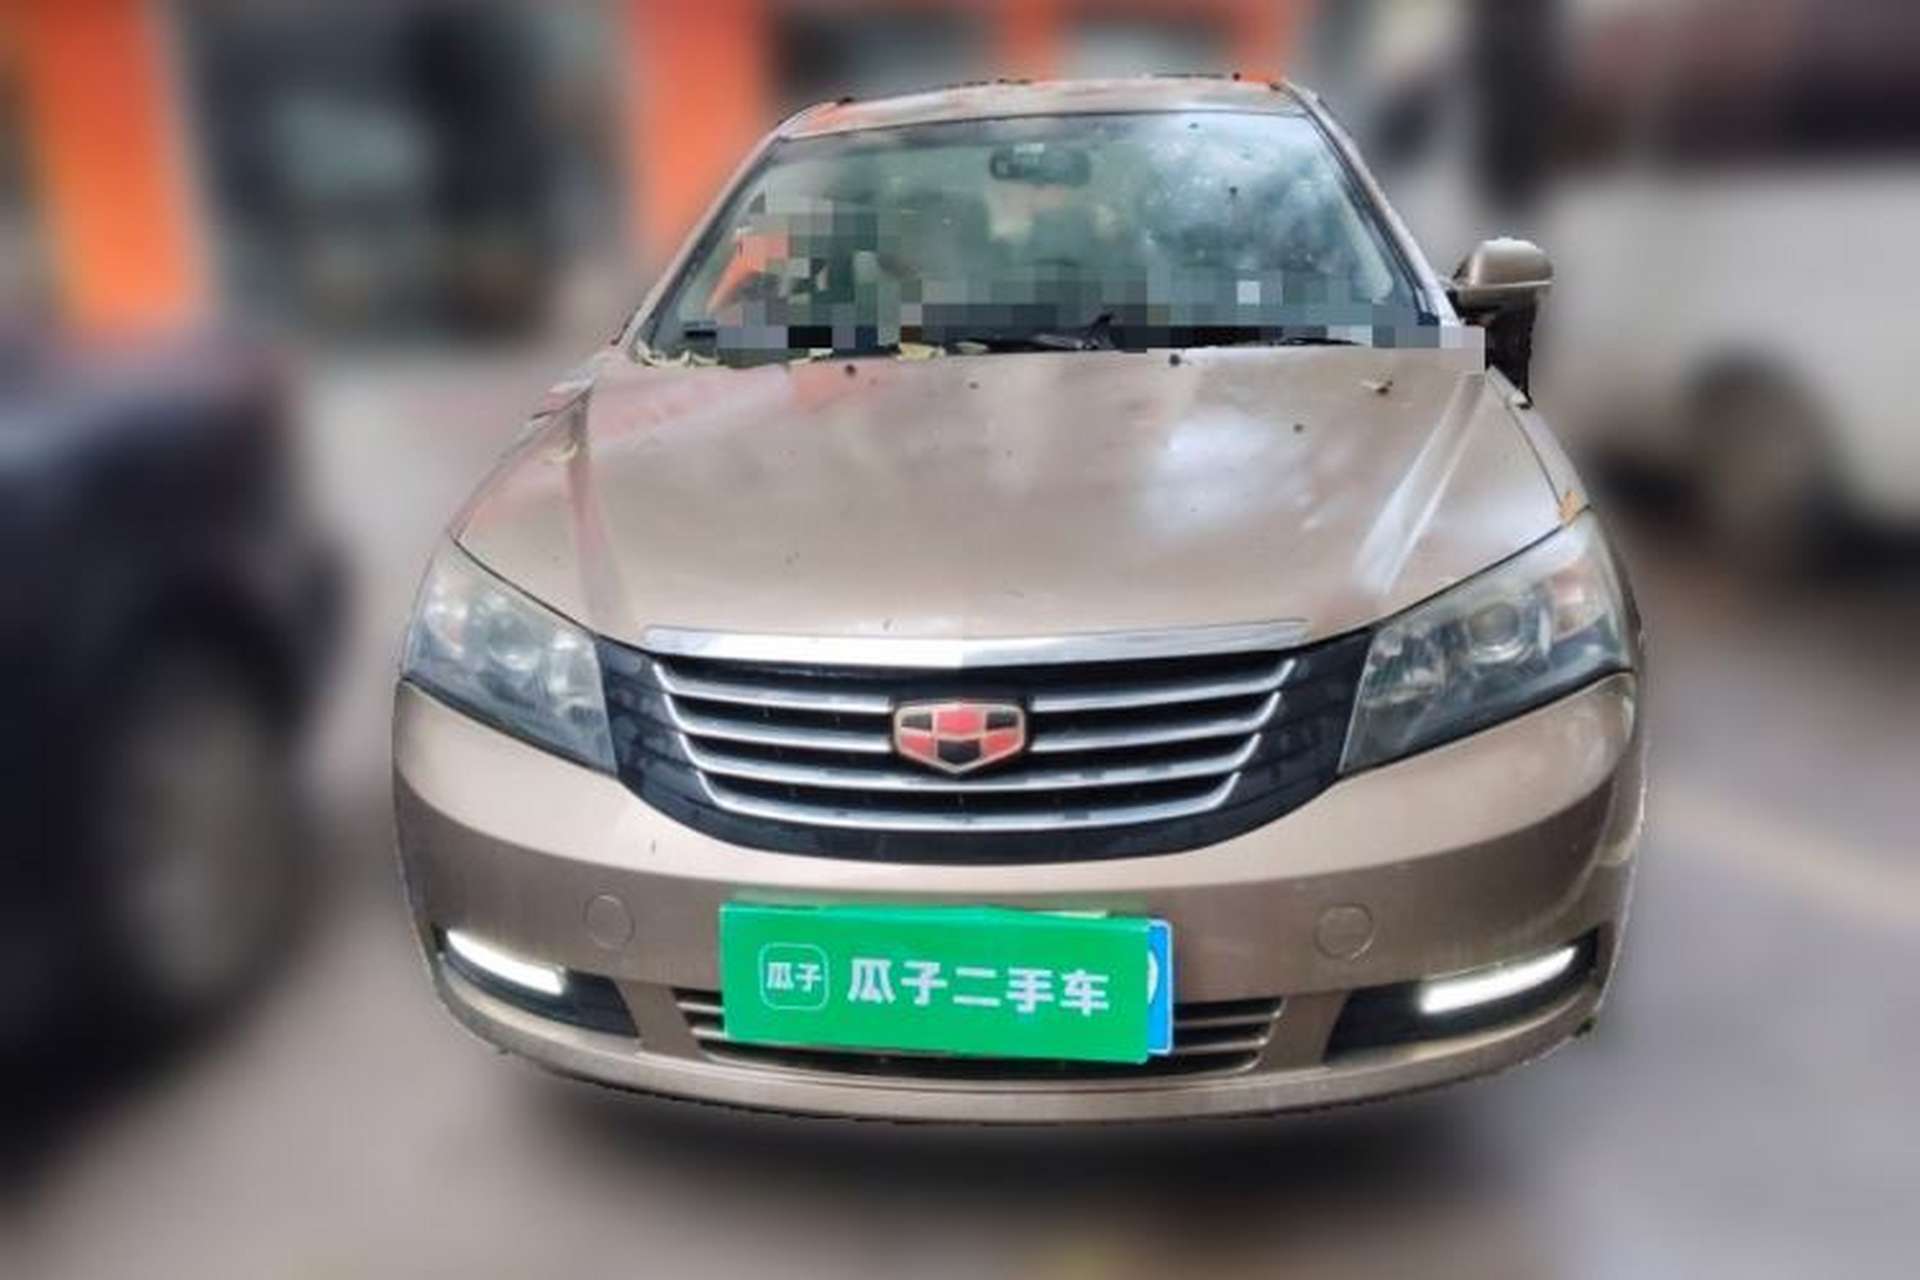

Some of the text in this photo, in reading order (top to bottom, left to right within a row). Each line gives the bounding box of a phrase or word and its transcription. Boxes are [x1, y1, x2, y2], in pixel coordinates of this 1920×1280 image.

[766, 962, 822, 992] 瓜子
[847, 957, 1109, 1016] 瓜子二手车
